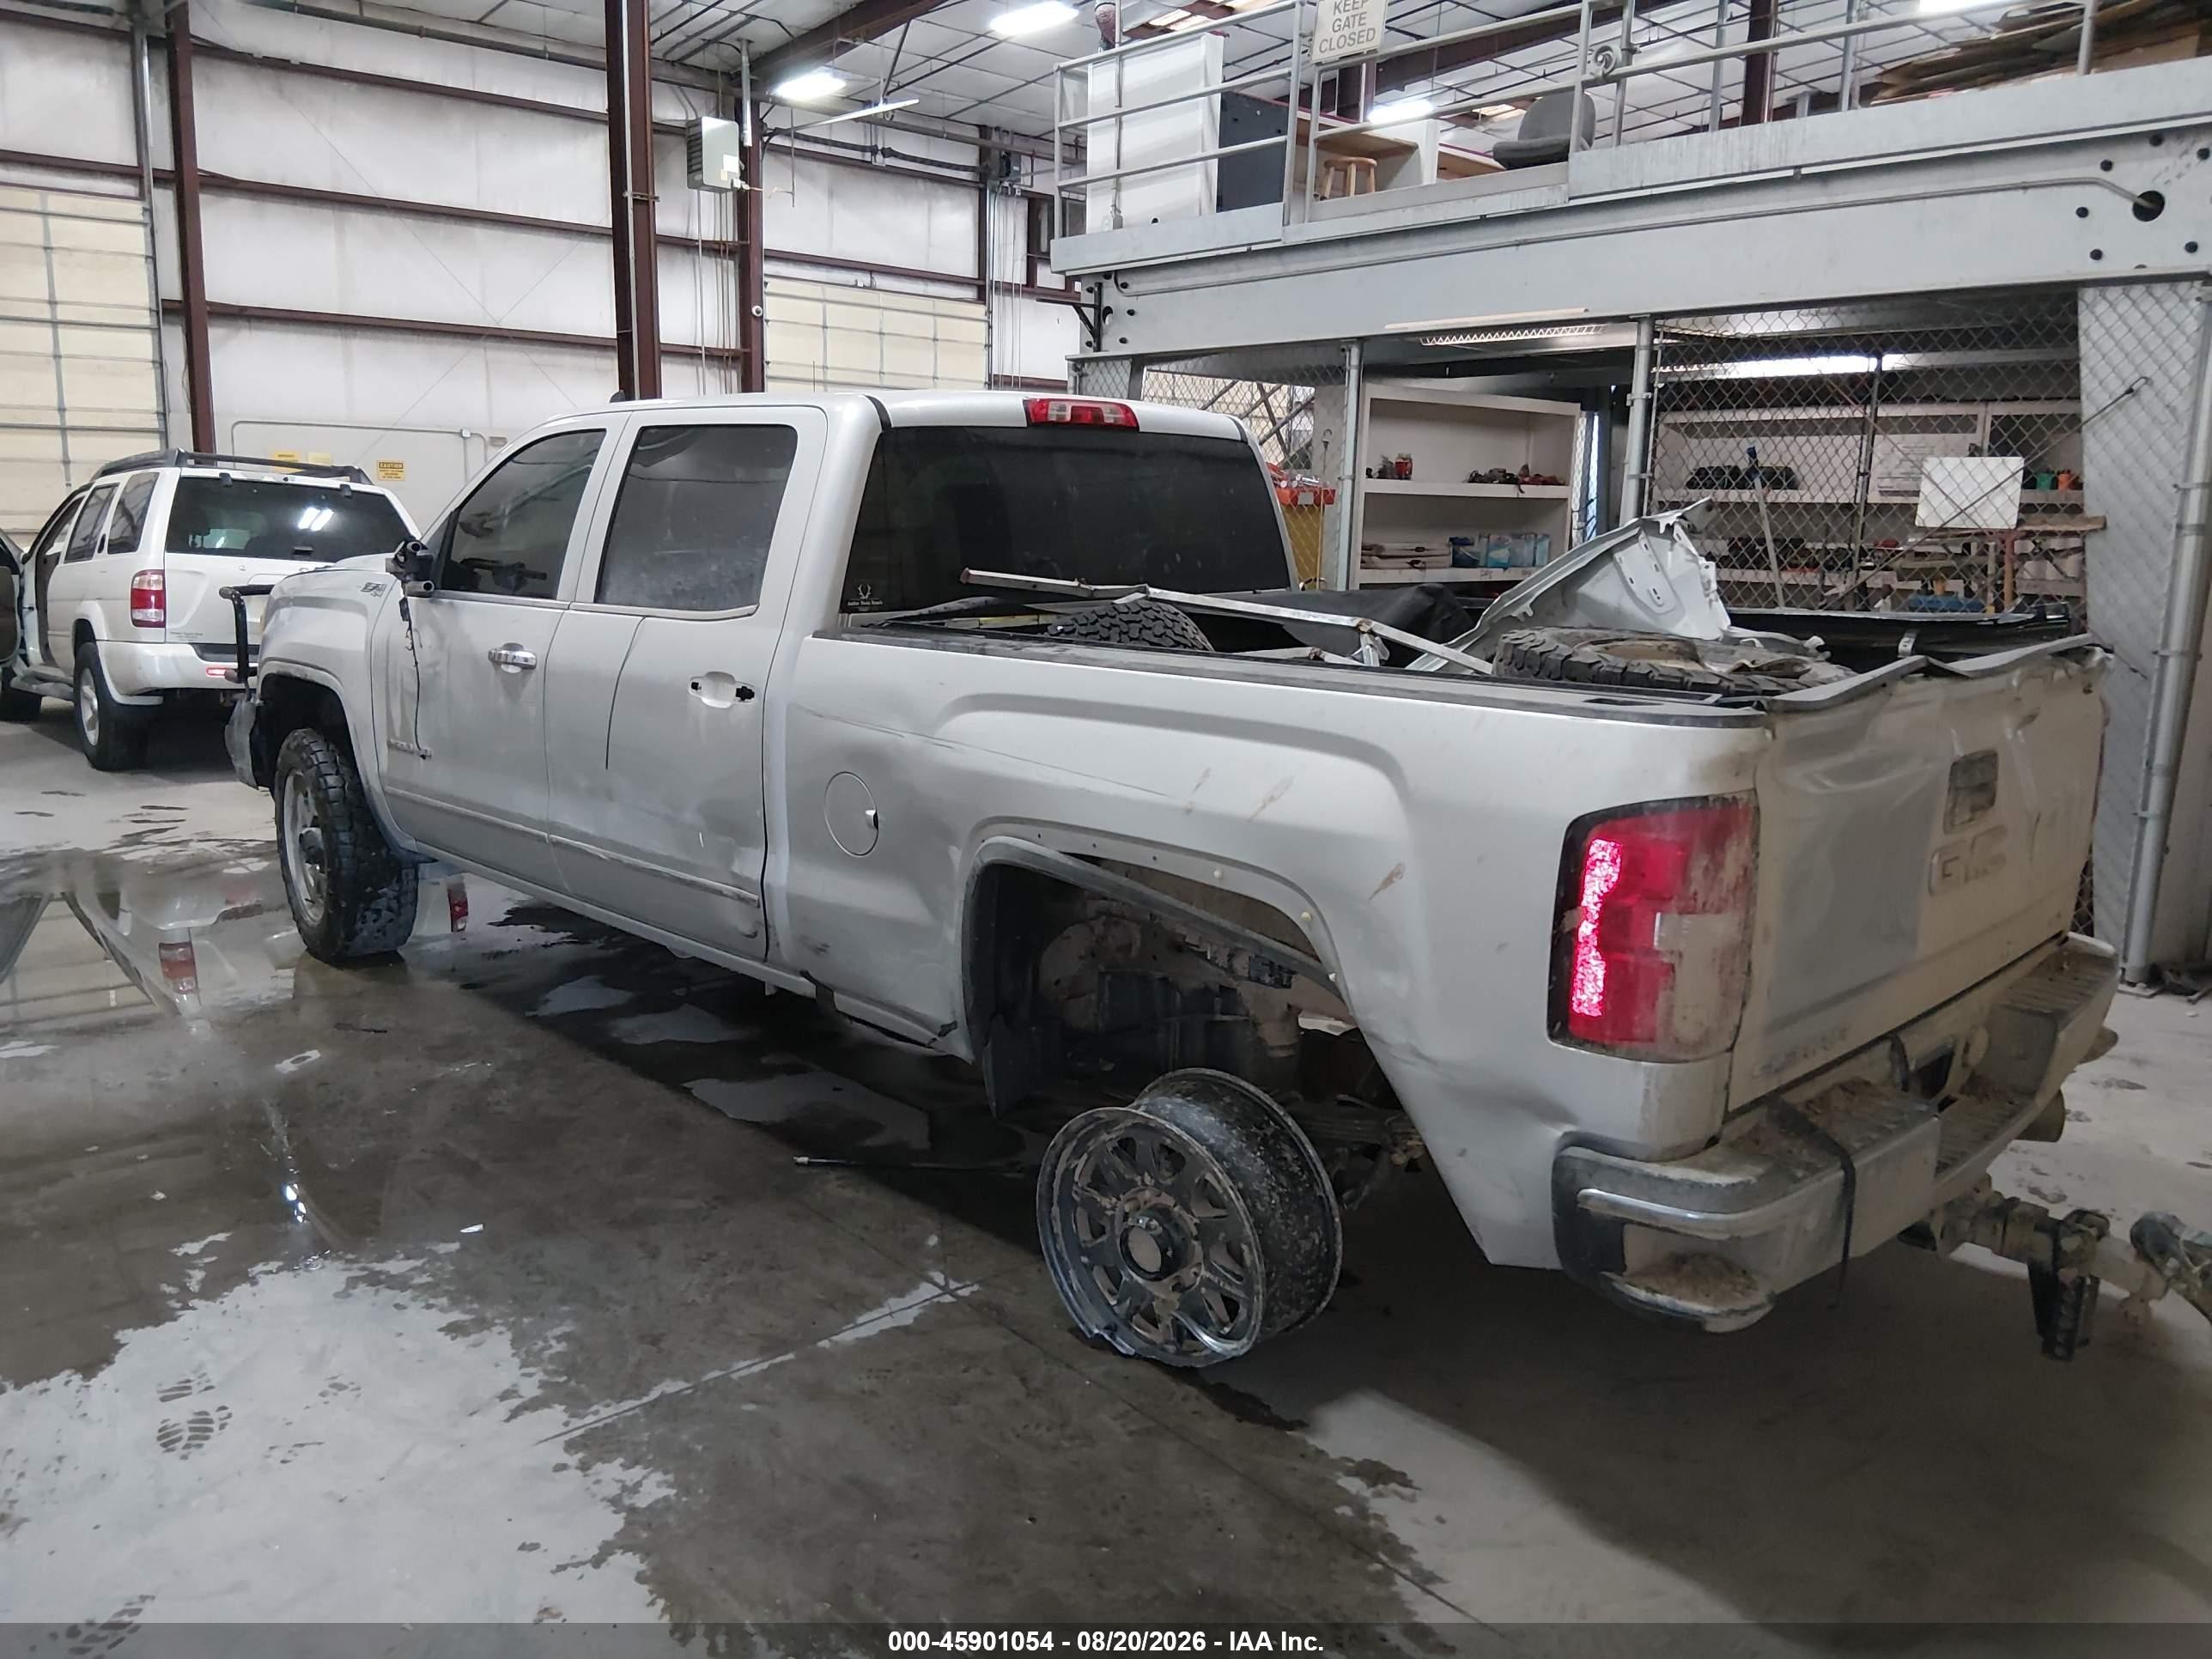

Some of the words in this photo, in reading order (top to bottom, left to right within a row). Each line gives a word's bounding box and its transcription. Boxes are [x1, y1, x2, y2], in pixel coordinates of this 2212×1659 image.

[1333, 0, 1369, 15] KEEP
[1332, 11, 1367, 33] GATE
[1319, 27, 1376, 53] CLOSED
